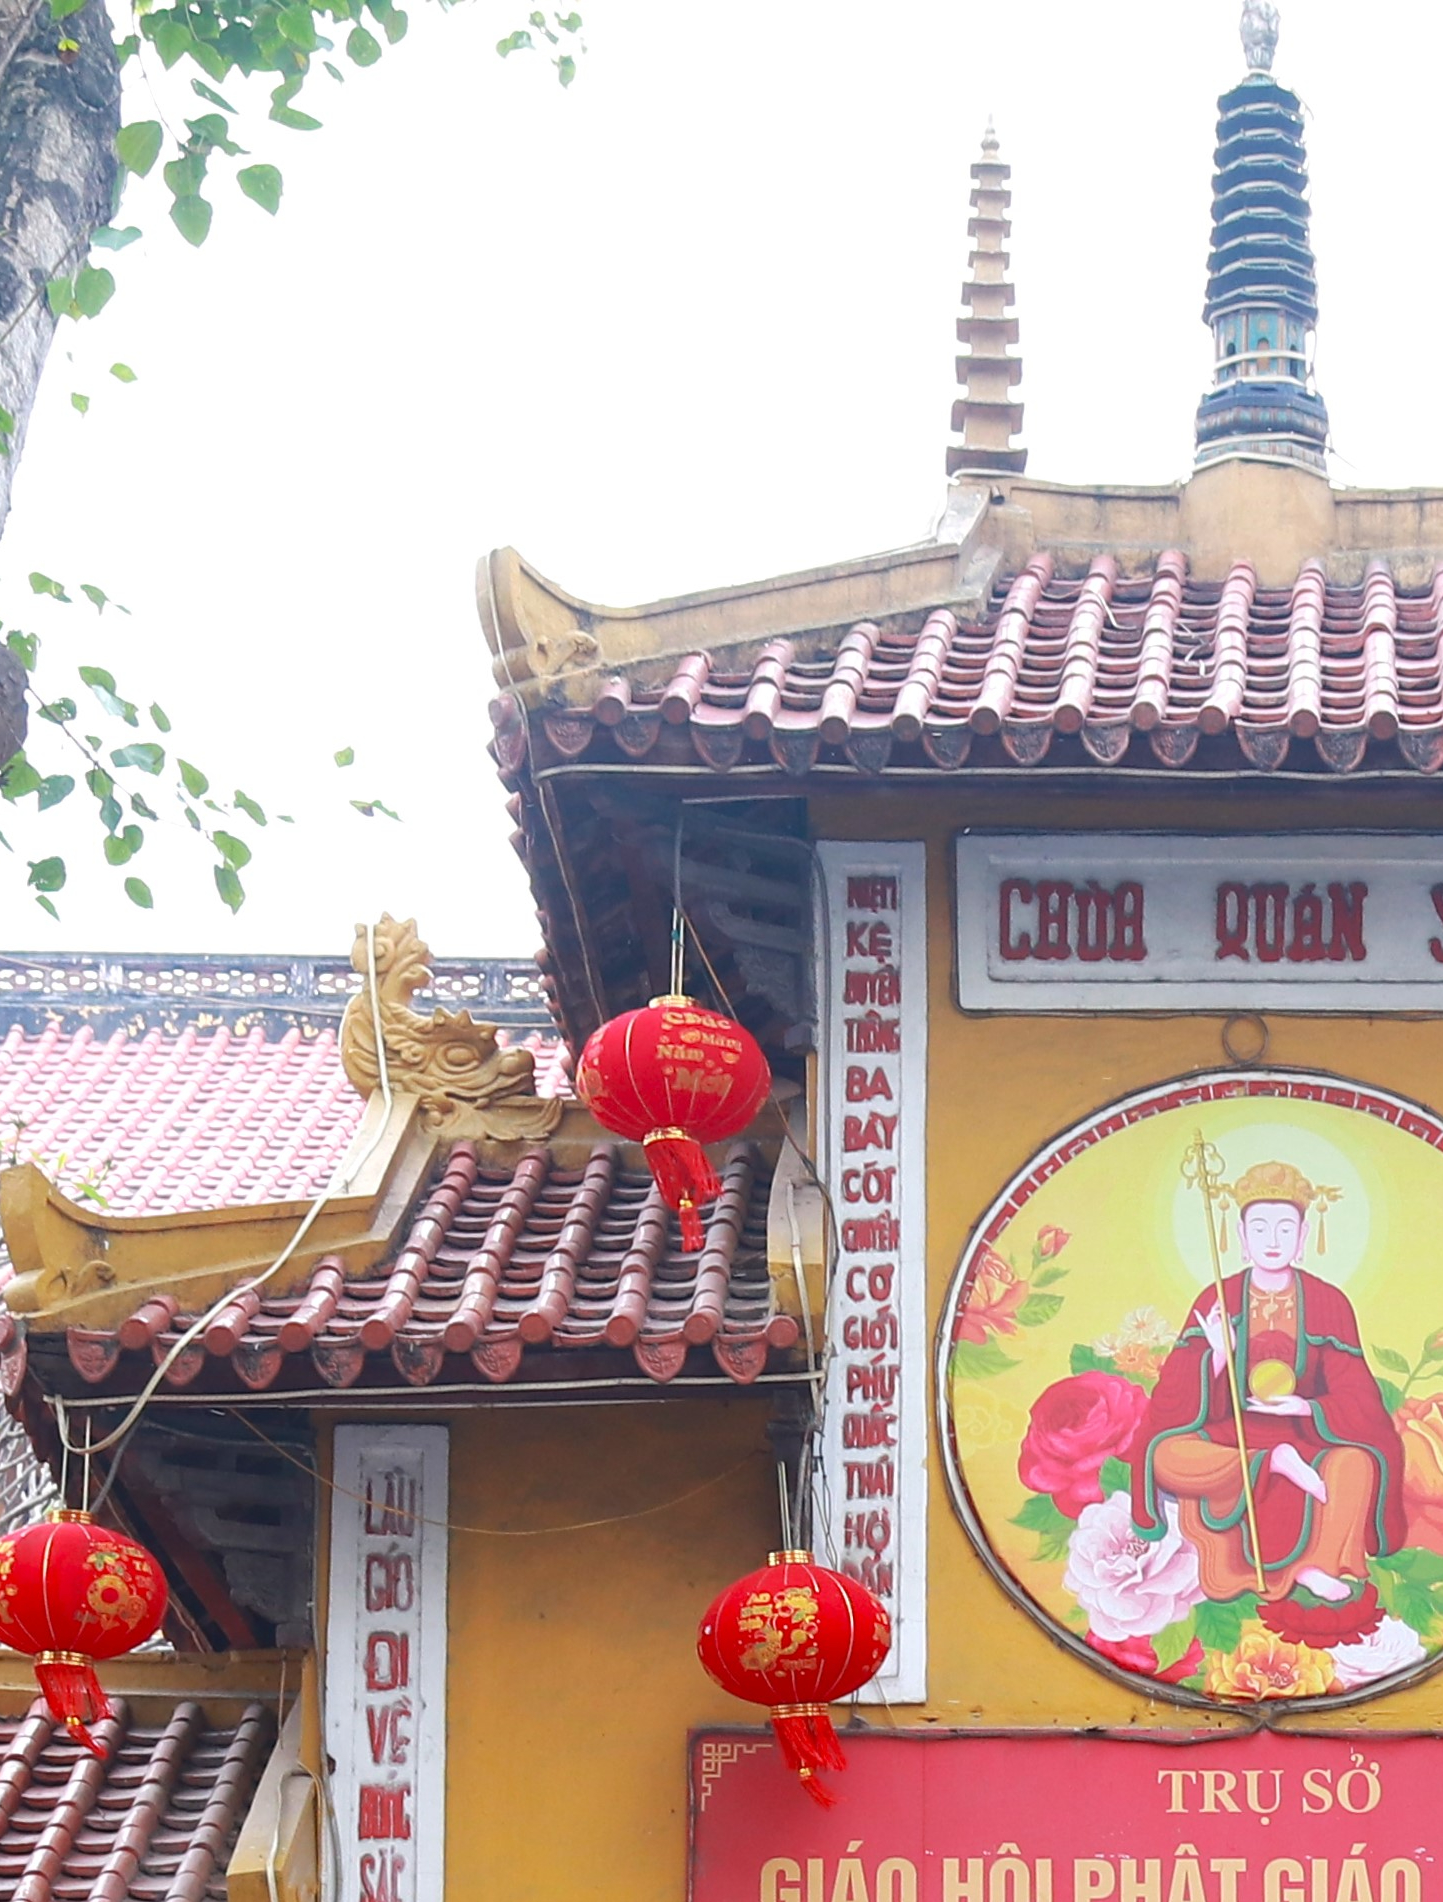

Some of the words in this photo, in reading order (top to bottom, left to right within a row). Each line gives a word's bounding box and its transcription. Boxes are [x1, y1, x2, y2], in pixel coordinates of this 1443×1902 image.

[998, 879, 1148, 962] CHÙA
[1215, 882, 1369, 964] QUÁN
[656, 1043, 706, 1063] Năm
[846, 1065, 893, 1103] BA
[846, 1263, 895, 1303] CƠ
[842, 1304, 899, 1352] GIỚI
[843, 1455, 895, 1500] THÁI
[364, 1540, 414, 1613] GIÓ
[363, 1630, 411, 1694] ĐI
[1158, 1769, 1277, 1826] TRỤ
[1302, 1757, 1382, 1814] SỞ
